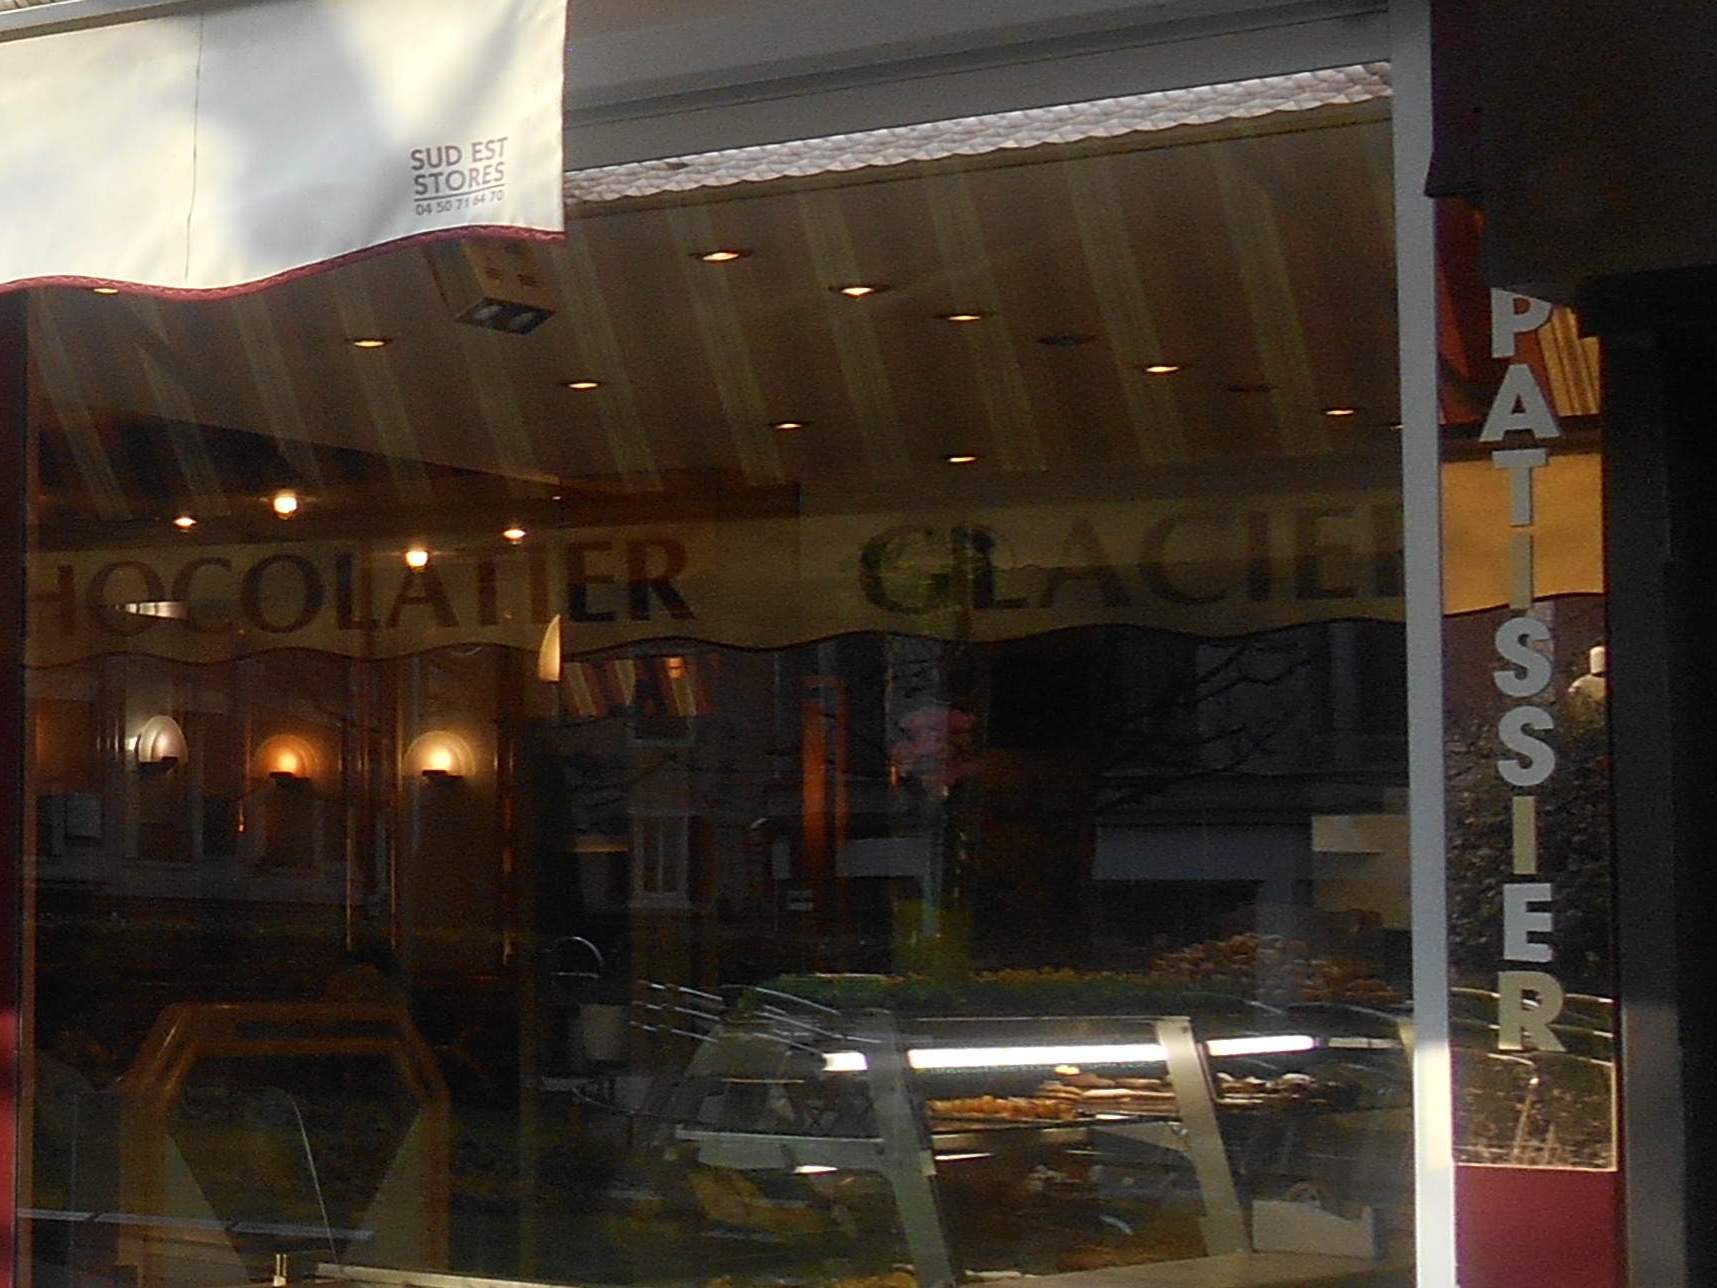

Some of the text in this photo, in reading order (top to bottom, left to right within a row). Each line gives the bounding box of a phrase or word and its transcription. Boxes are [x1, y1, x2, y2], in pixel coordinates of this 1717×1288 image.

[410, 137, 508, 171] SUD EST
[414, 162, 505, 197] STORES
[416, 201, 432, 216] 04
[436, 198, 452, 214] 50
[455, 196, 469, 212] 71
[489, 189, 504, 203] 70
[1479, 288, 1565, 1054] PATISSIER
